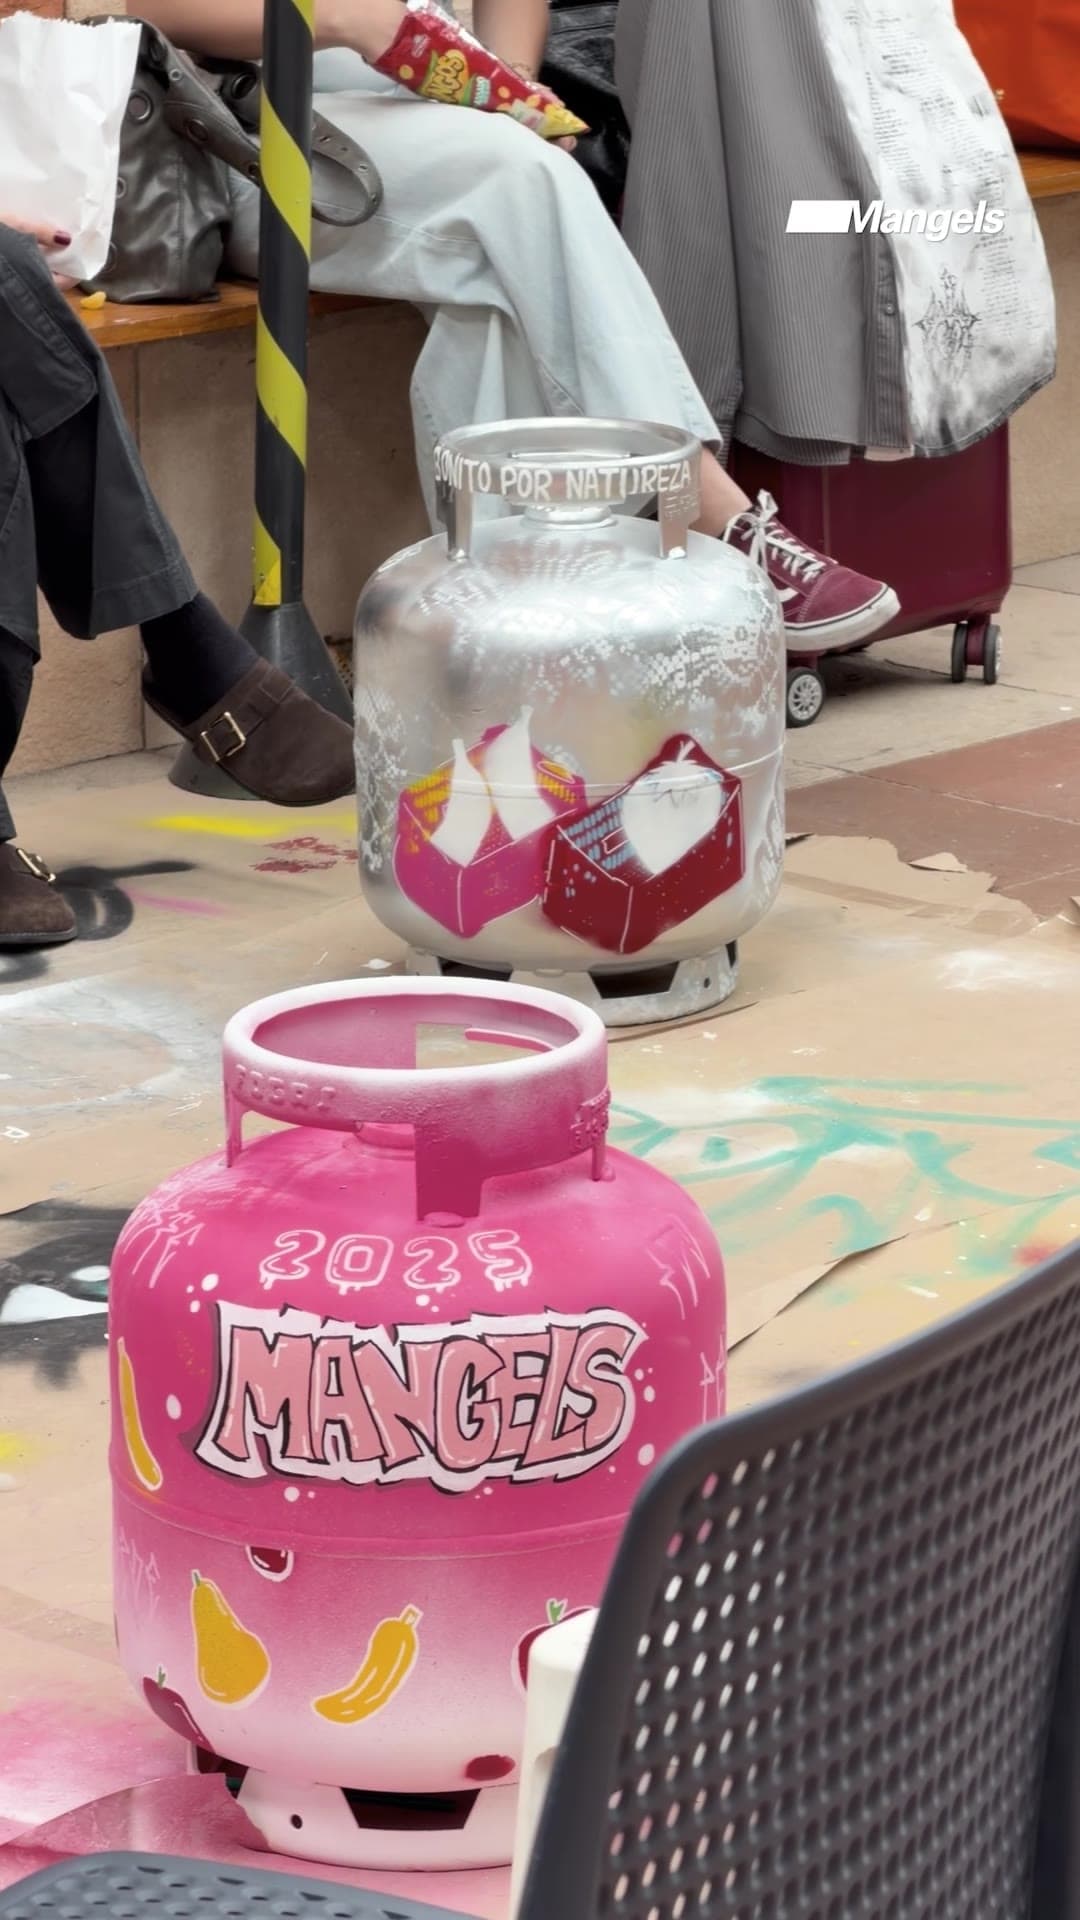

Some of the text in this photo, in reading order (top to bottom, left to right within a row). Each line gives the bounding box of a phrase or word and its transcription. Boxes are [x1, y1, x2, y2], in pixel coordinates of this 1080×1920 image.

[500, 464, 552, 501] POR
[566, 460, 691, 500] NATUREZA
[259, 1229, 532, 1295] 2025
[207, 1316, 643, 1475] MANGELS
